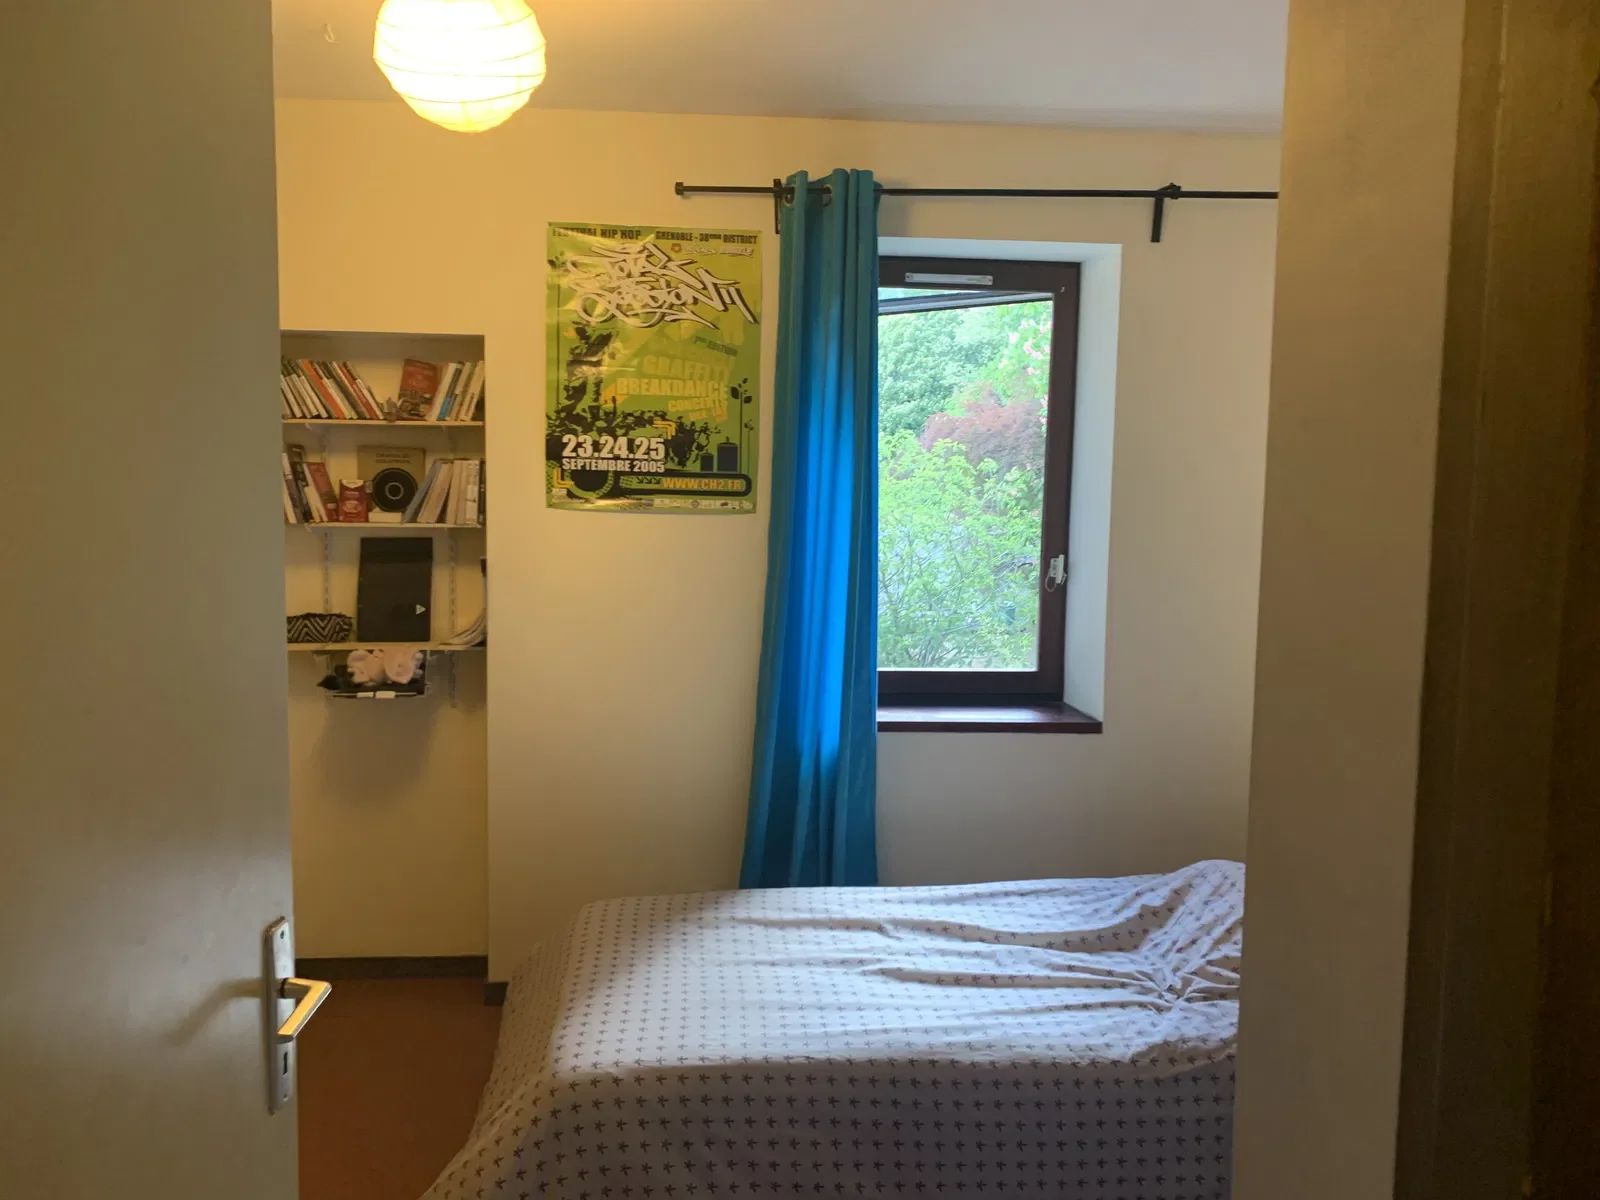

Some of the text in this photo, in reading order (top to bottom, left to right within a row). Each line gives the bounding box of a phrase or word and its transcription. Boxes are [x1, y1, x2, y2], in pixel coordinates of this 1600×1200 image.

[600, 228, 618, 239] HIP
[620, 229, 642, 240] HOP
[655, 231, 693, 241] GRENOBLE
[723, 233, 758, 244] DISTRICT
[561, 434, 665, 460] 23.24.25
[561, 458, 665, 473] SEPTEMBRE 2005
[662, 477, 742, 490] WWW.CH2.FR
